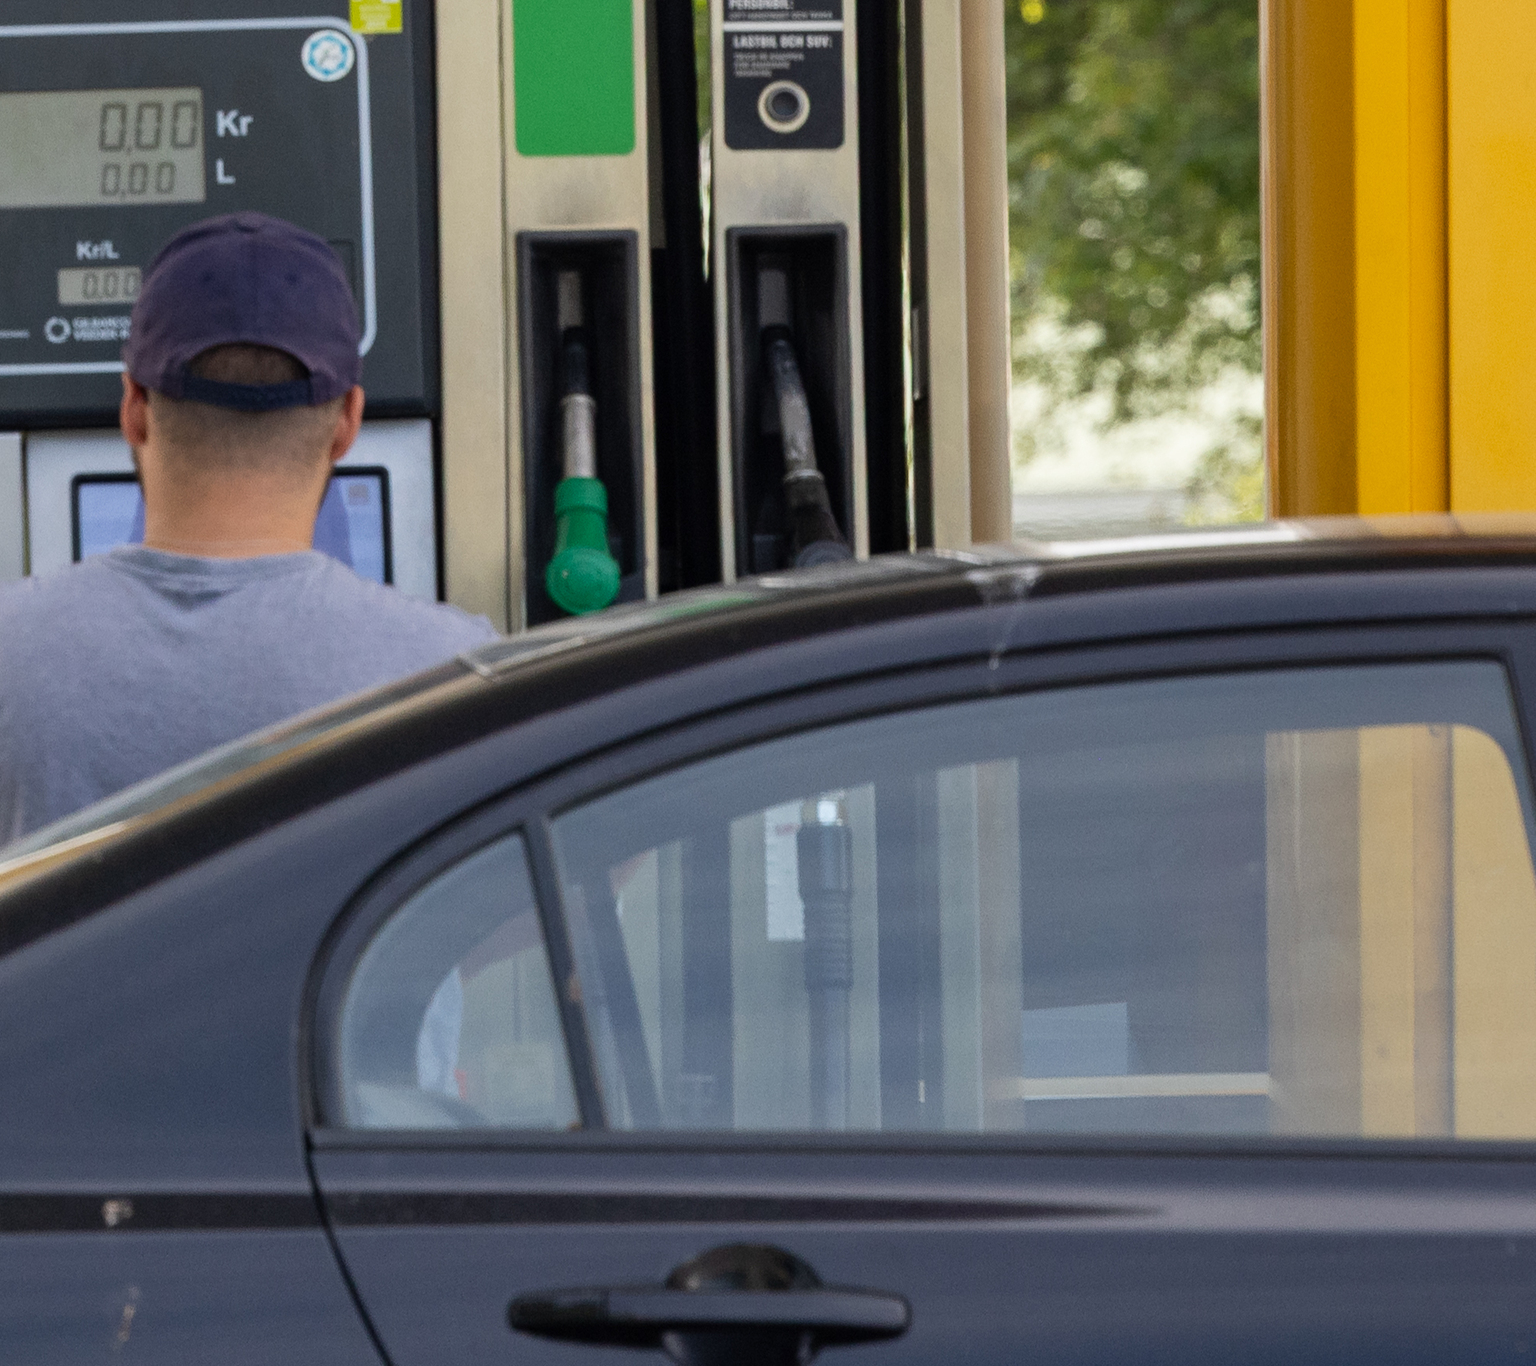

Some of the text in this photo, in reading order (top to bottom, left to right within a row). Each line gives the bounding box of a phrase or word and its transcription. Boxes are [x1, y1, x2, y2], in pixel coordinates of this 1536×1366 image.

[216, 109, 254, 137] Kr
[216, 158, 236, 184] L
[76, 240, 120, 260] Kr/L
